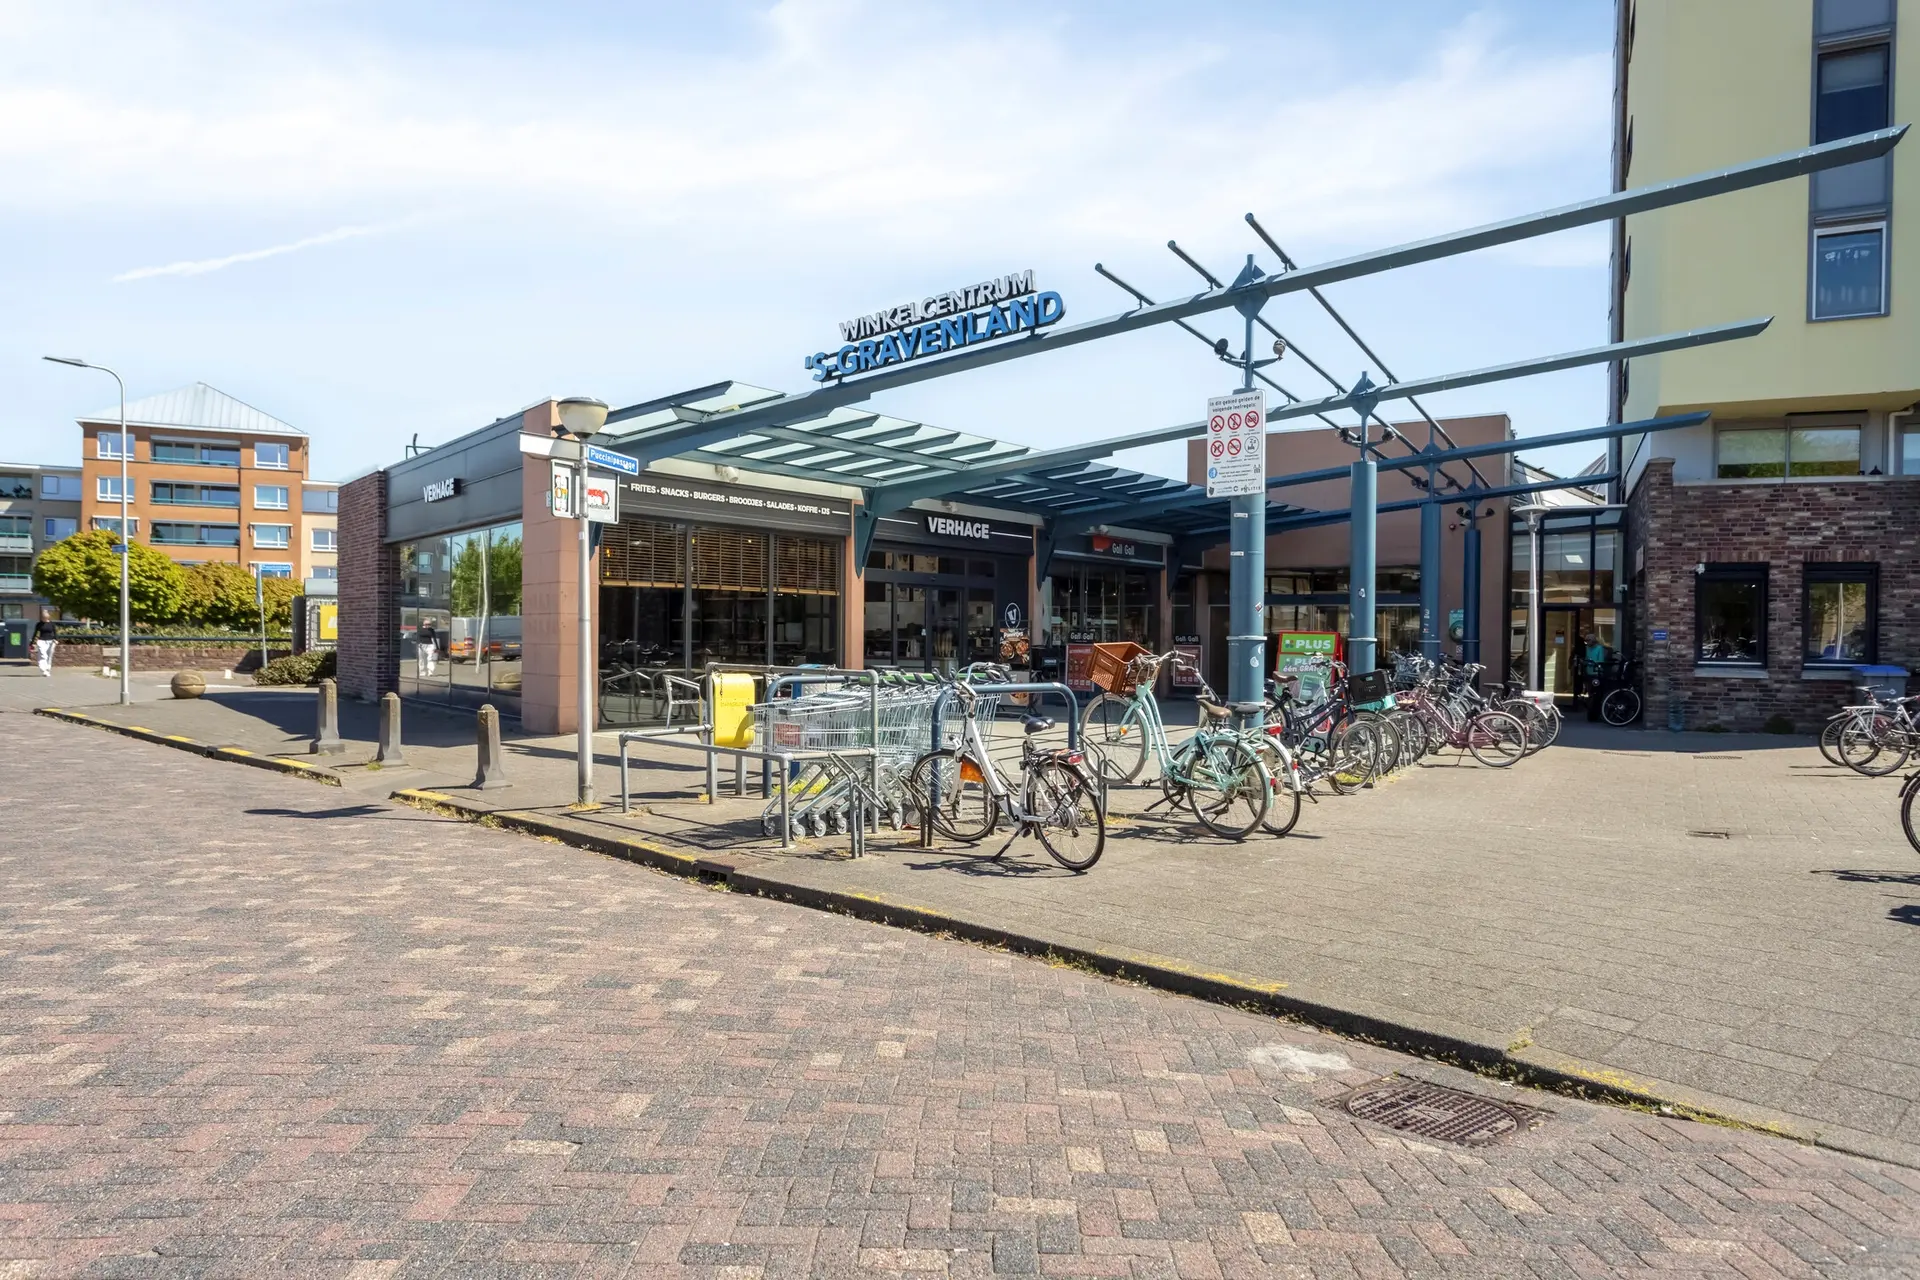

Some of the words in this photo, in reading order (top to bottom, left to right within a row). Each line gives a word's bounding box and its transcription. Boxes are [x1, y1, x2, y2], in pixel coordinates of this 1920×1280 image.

[838, 269, 1036, 342] WINKELCENTRUM
[805, 291, 1066, 382] 'S-GRAVENLAND
[590, 449, 635, 471] Puccinipassage
[423, 477, 455, 503] VERHAGE
[630, 483, 656, 494] FRITES
[660, 486, 689, 498] SNACKS
[693, 491, 725, 502] BURGERS
[729, 495, 763, 507] BROODJES
[766, 500, 795, 511] SALADES
[797, 504, 818, 514] KOFFIE
[927, 516, 990, 539] VERHAGE
[1112, 542, 1122, 554] Gall
[1124, 544, 1135, 556] Gall
[1070, 632, 1082, 640] Gall
[1083, 632, 1094, 640] Gall
[1295, 639, 1331, 649] PLUS
[1283, 664, 1297, 672] één
